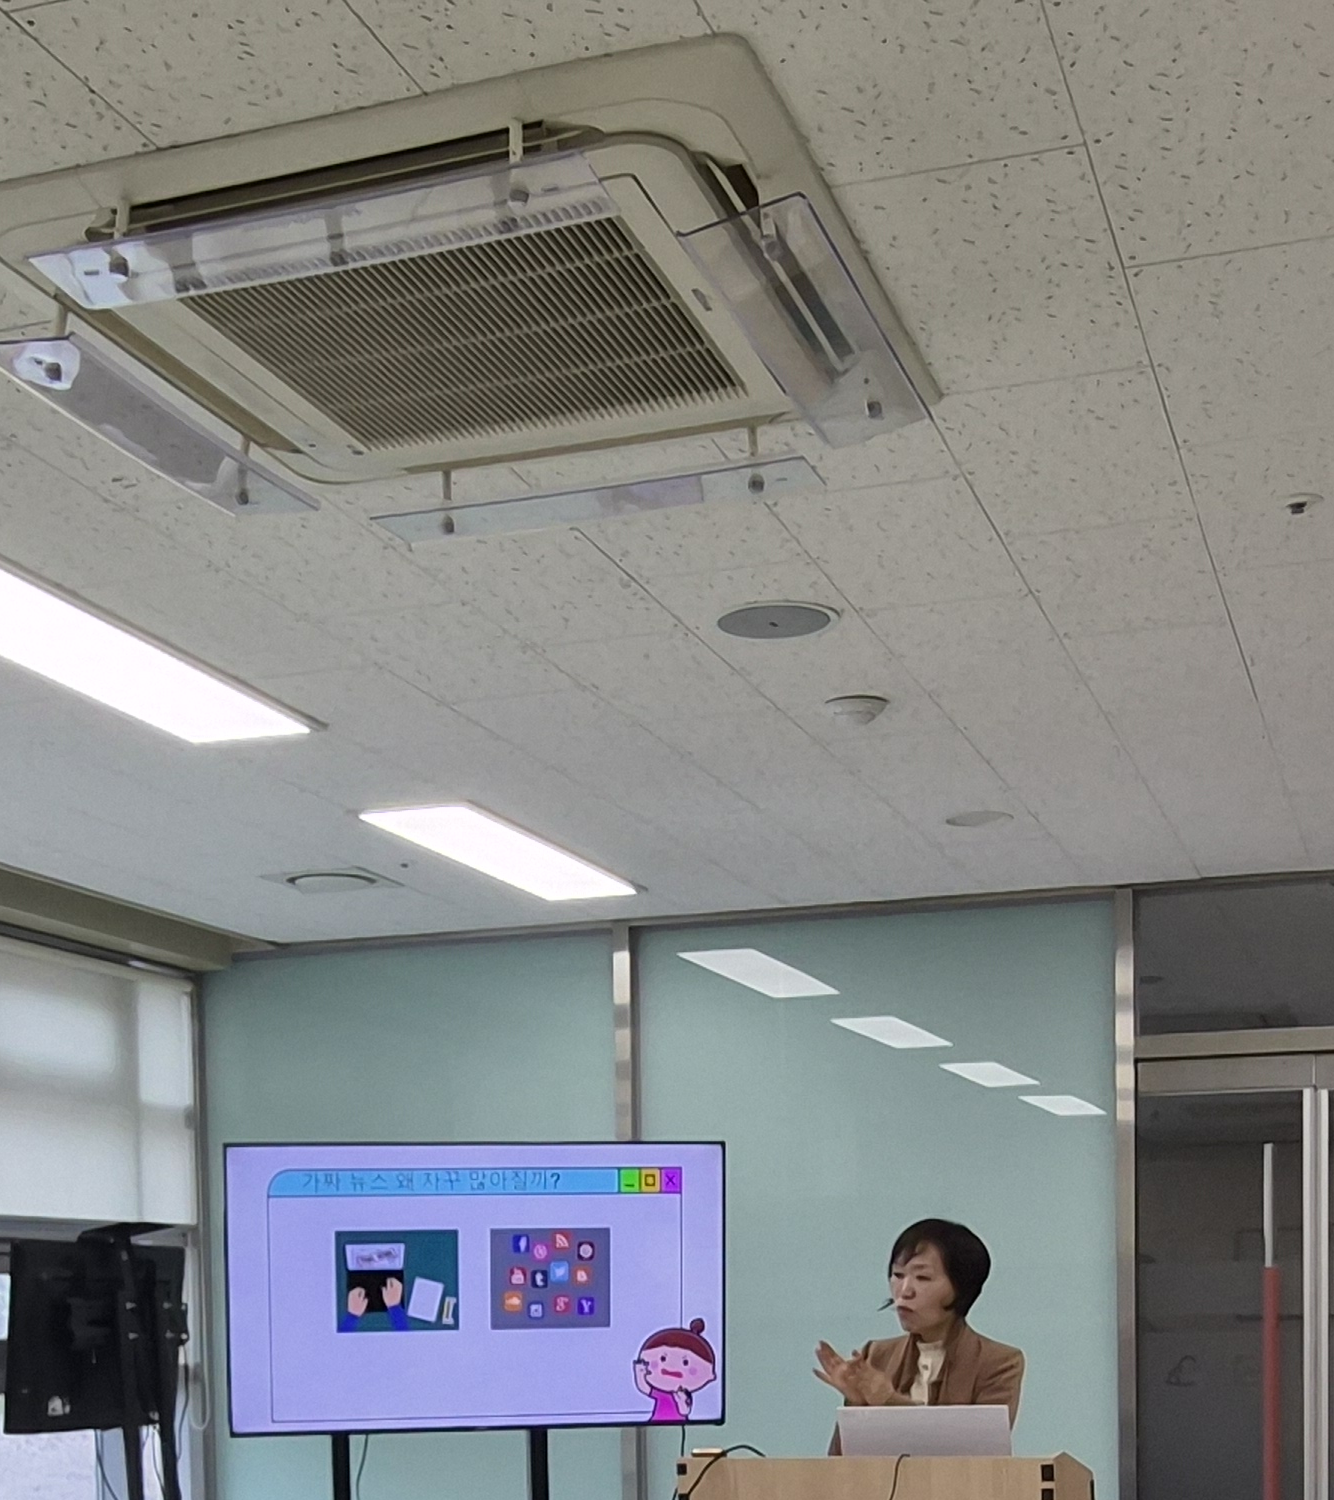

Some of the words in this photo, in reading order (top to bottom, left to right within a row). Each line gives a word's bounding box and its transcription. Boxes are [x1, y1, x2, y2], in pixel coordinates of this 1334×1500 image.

[303, 1172, 341, 1194] 가짜
[350, 1172, 389, 1192] 뉴스
[396, 1171, 415, 1192] 왜
[423, 1170, 461, 1192] 자꾸
[468, 1169, 561, 1192] 많아질까?
